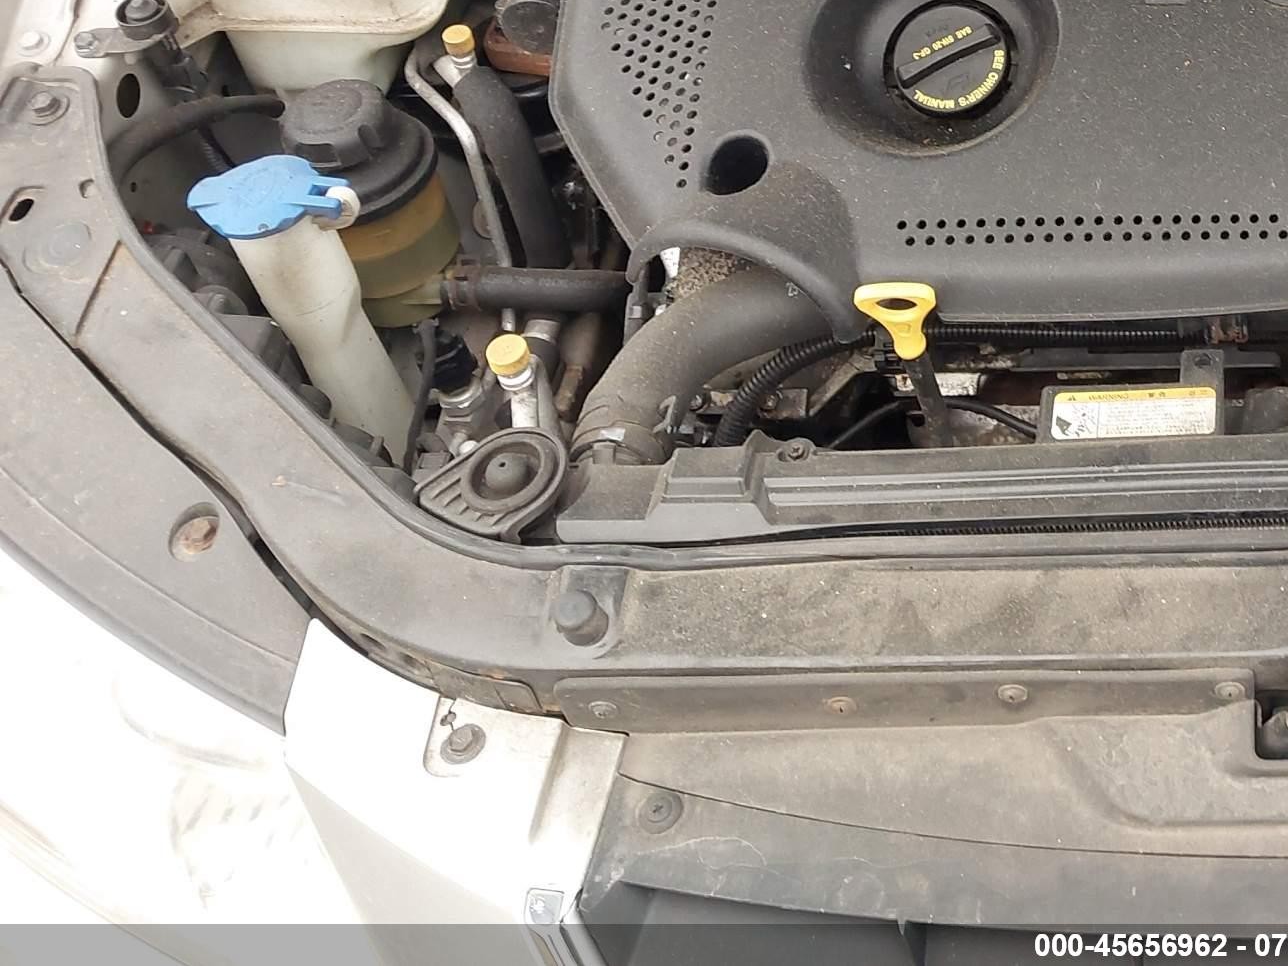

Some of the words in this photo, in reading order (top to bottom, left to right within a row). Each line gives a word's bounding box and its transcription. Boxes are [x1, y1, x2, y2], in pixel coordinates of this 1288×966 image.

[955, 25, 973, 40] SAE
[991, 49, 1006, 71] SEE
[913, 89, 956, 110] MANUAL
[957, 71, 1000, 108] OWNER'S
[1088, 392, 1130, 401] WARNING
